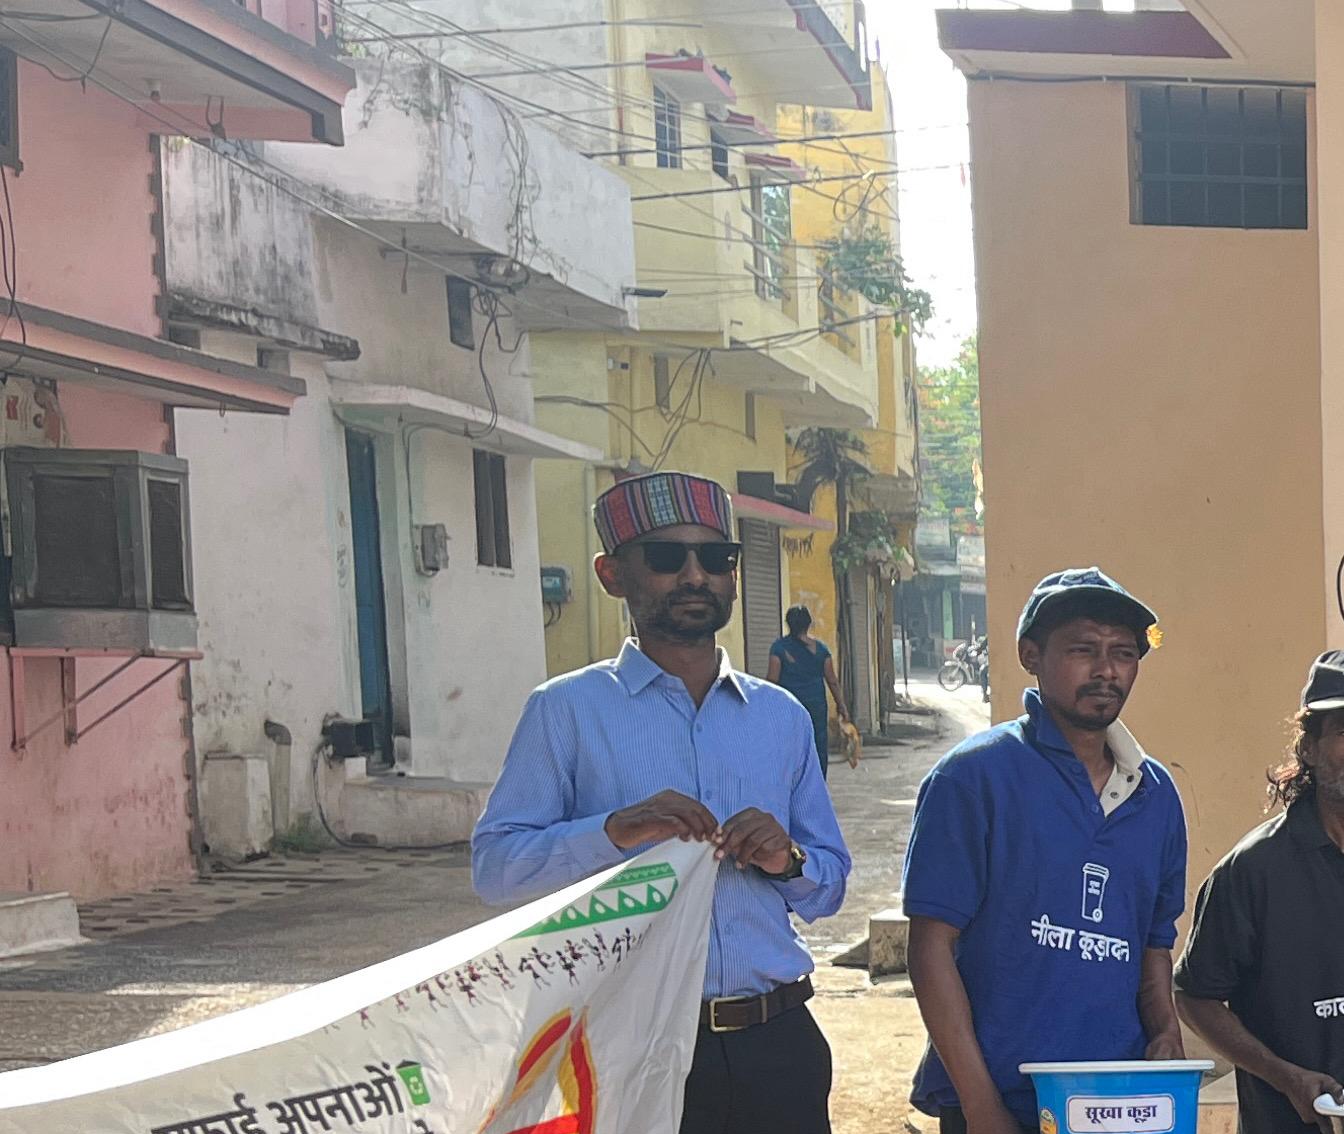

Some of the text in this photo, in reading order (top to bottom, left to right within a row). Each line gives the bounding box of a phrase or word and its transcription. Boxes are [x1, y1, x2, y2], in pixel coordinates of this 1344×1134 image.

[1031, 913, 1130, 962] नीला कूड़ादन
[1084, 1106, 1123, 1124] सूखा
